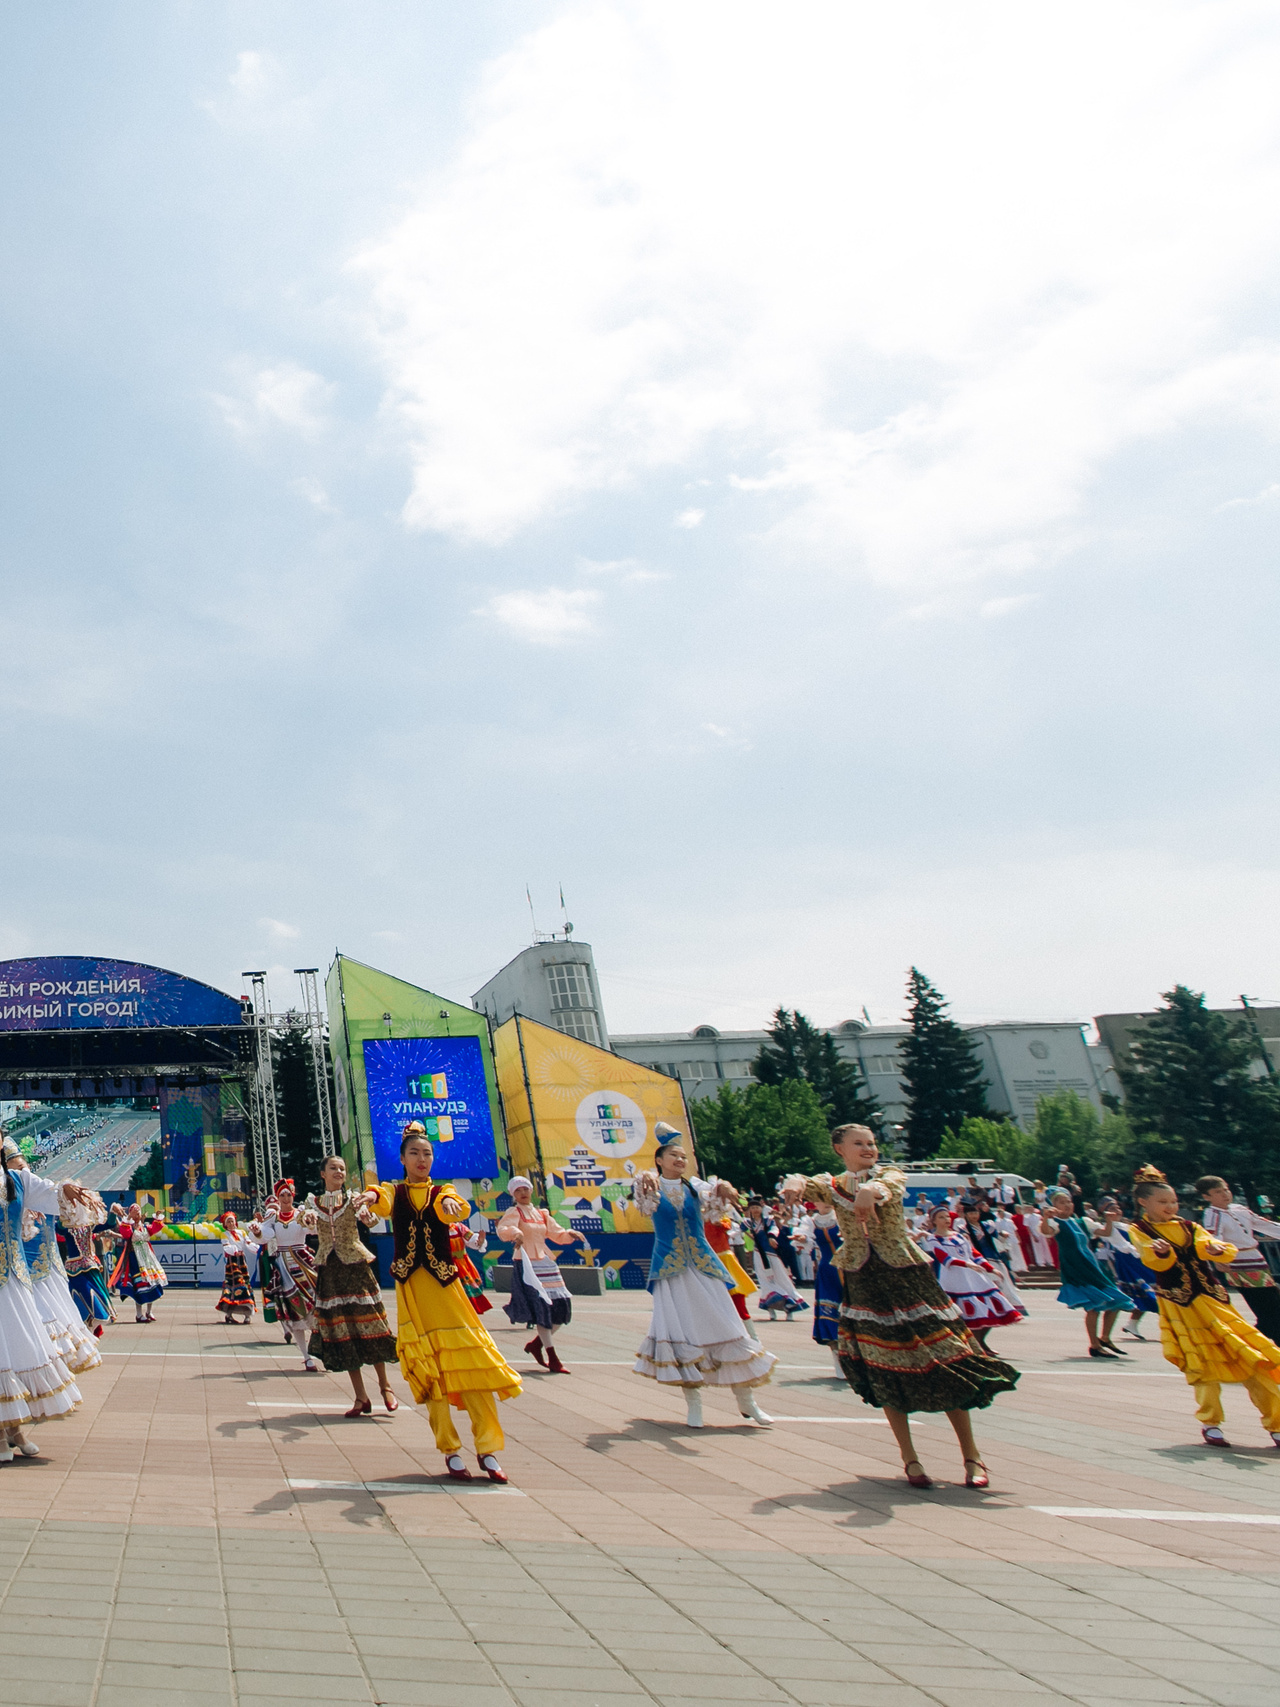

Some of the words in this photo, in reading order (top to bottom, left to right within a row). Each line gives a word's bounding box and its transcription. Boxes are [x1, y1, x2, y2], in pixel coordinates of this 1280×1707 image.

[29, 979, 146, 997] РОЖДЕНИЯ,
[67, 1001, 139, 1017] ГОРОД!
[392, 1100, 468, 1115] УЛАН-УДЭ
[589, 1120, 634, 1128] УЛАН-УДЭ
[160, 1253, 227, 1266] АРИГУ
